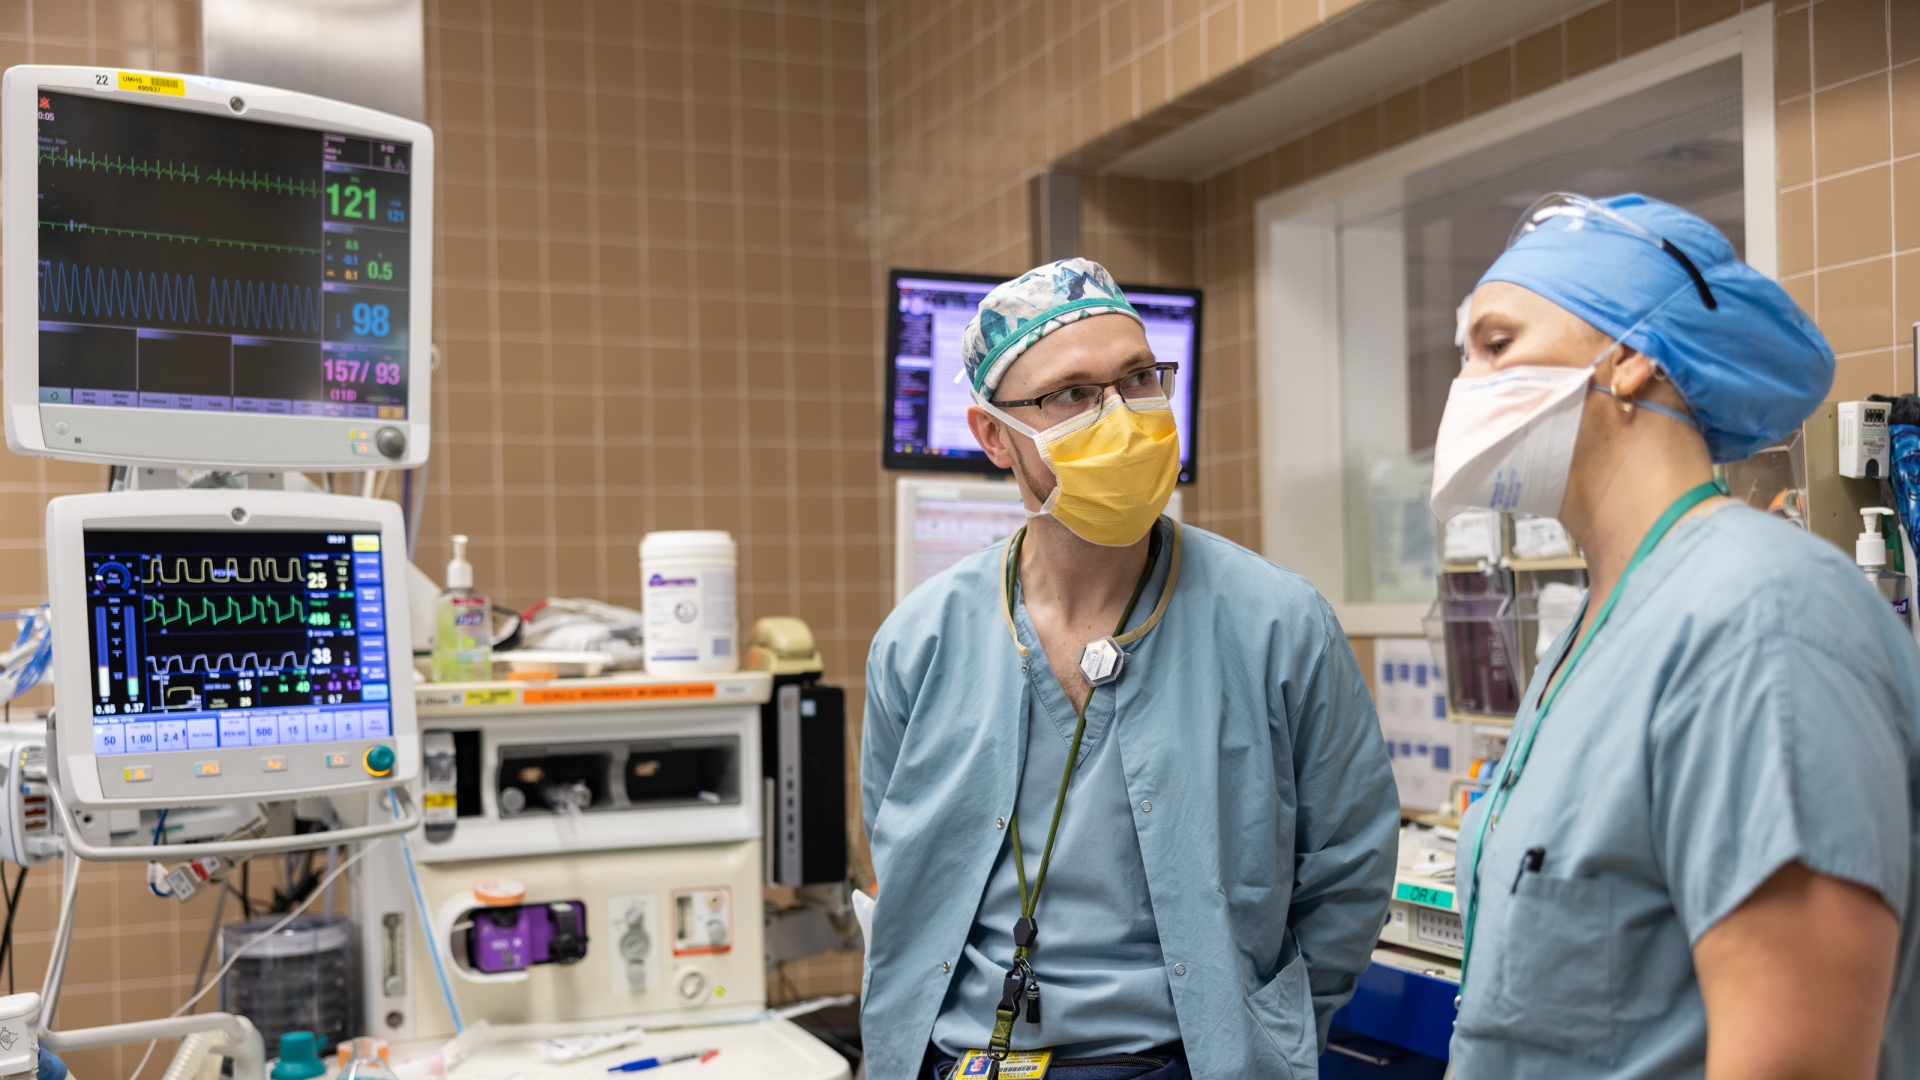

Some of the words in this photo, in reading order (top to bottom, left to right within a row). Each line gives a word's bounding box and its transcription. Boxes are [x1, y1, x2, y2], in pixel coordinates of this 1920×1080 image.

[95, 74, 109, 86] 22
[122, 75, 143, 84] UMHS
[326, 182, 377, 220] 121
[387, 209, 405, 223] 121
[345, 238, 359, 251] 0.5
[367, 260, 393, 281] 0.5
[352, 301, 391, 337] 98
[375, 362, 400, 385] 93
[306, 571, 328, 589] 25
[311, 647, 332, 665] 38
[237, 679, 252, 691] 15
[95, 704, 116, 715] 0.65
[124, 702, 144, 713] 0.37
[256, 728, 273, 737] 500
[288, 727, 299, 735] 15
[104, 736, 116, 746] 50
[131, 734, 152, 744] 1.00
[163, 733, 179, 743] 2.4
[1410, 886, 1428, 903] OR
[1430, 891, 1438, 905] 4
